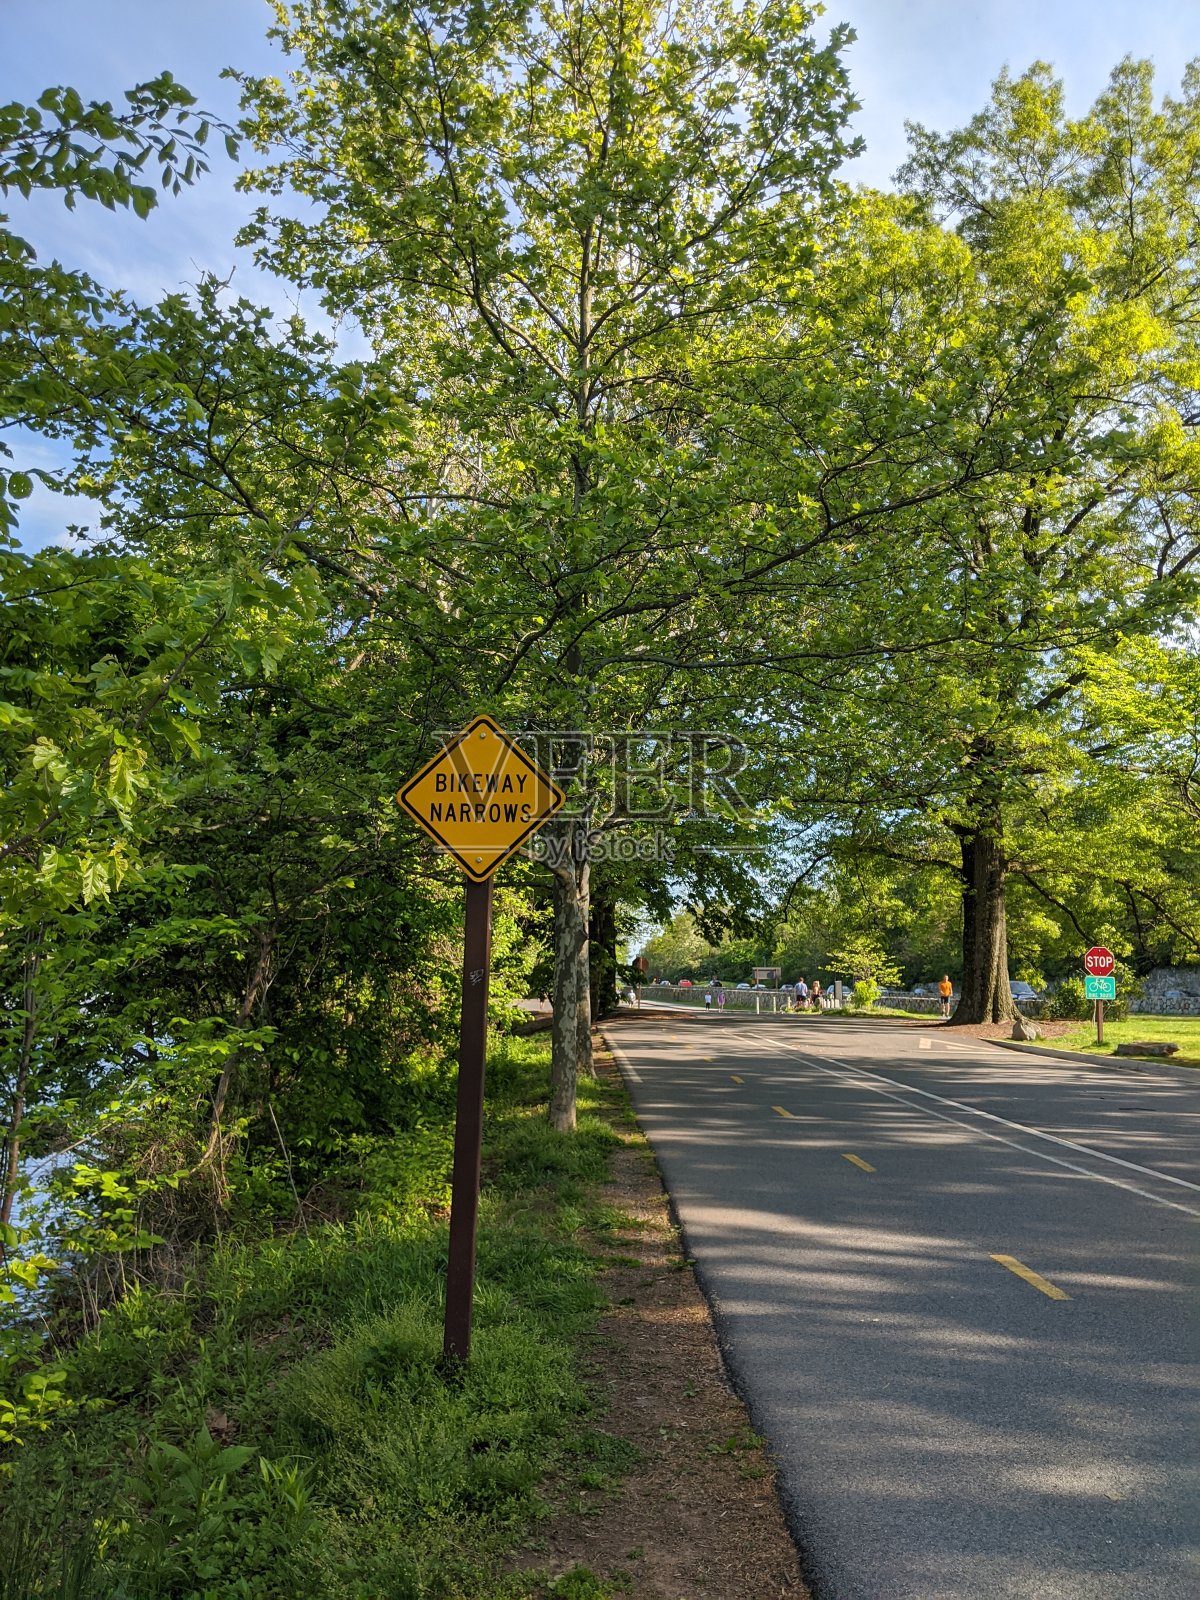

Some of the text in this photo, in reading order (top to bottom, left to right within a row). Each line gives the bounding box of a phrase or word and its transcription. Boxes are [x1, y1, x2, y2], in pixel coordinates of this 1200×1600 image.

[435, 773, 528, 793] BIKEWAY
[430, 803, 531, 823] NARROWS
[1087, 956, 1112, 967] STOP
